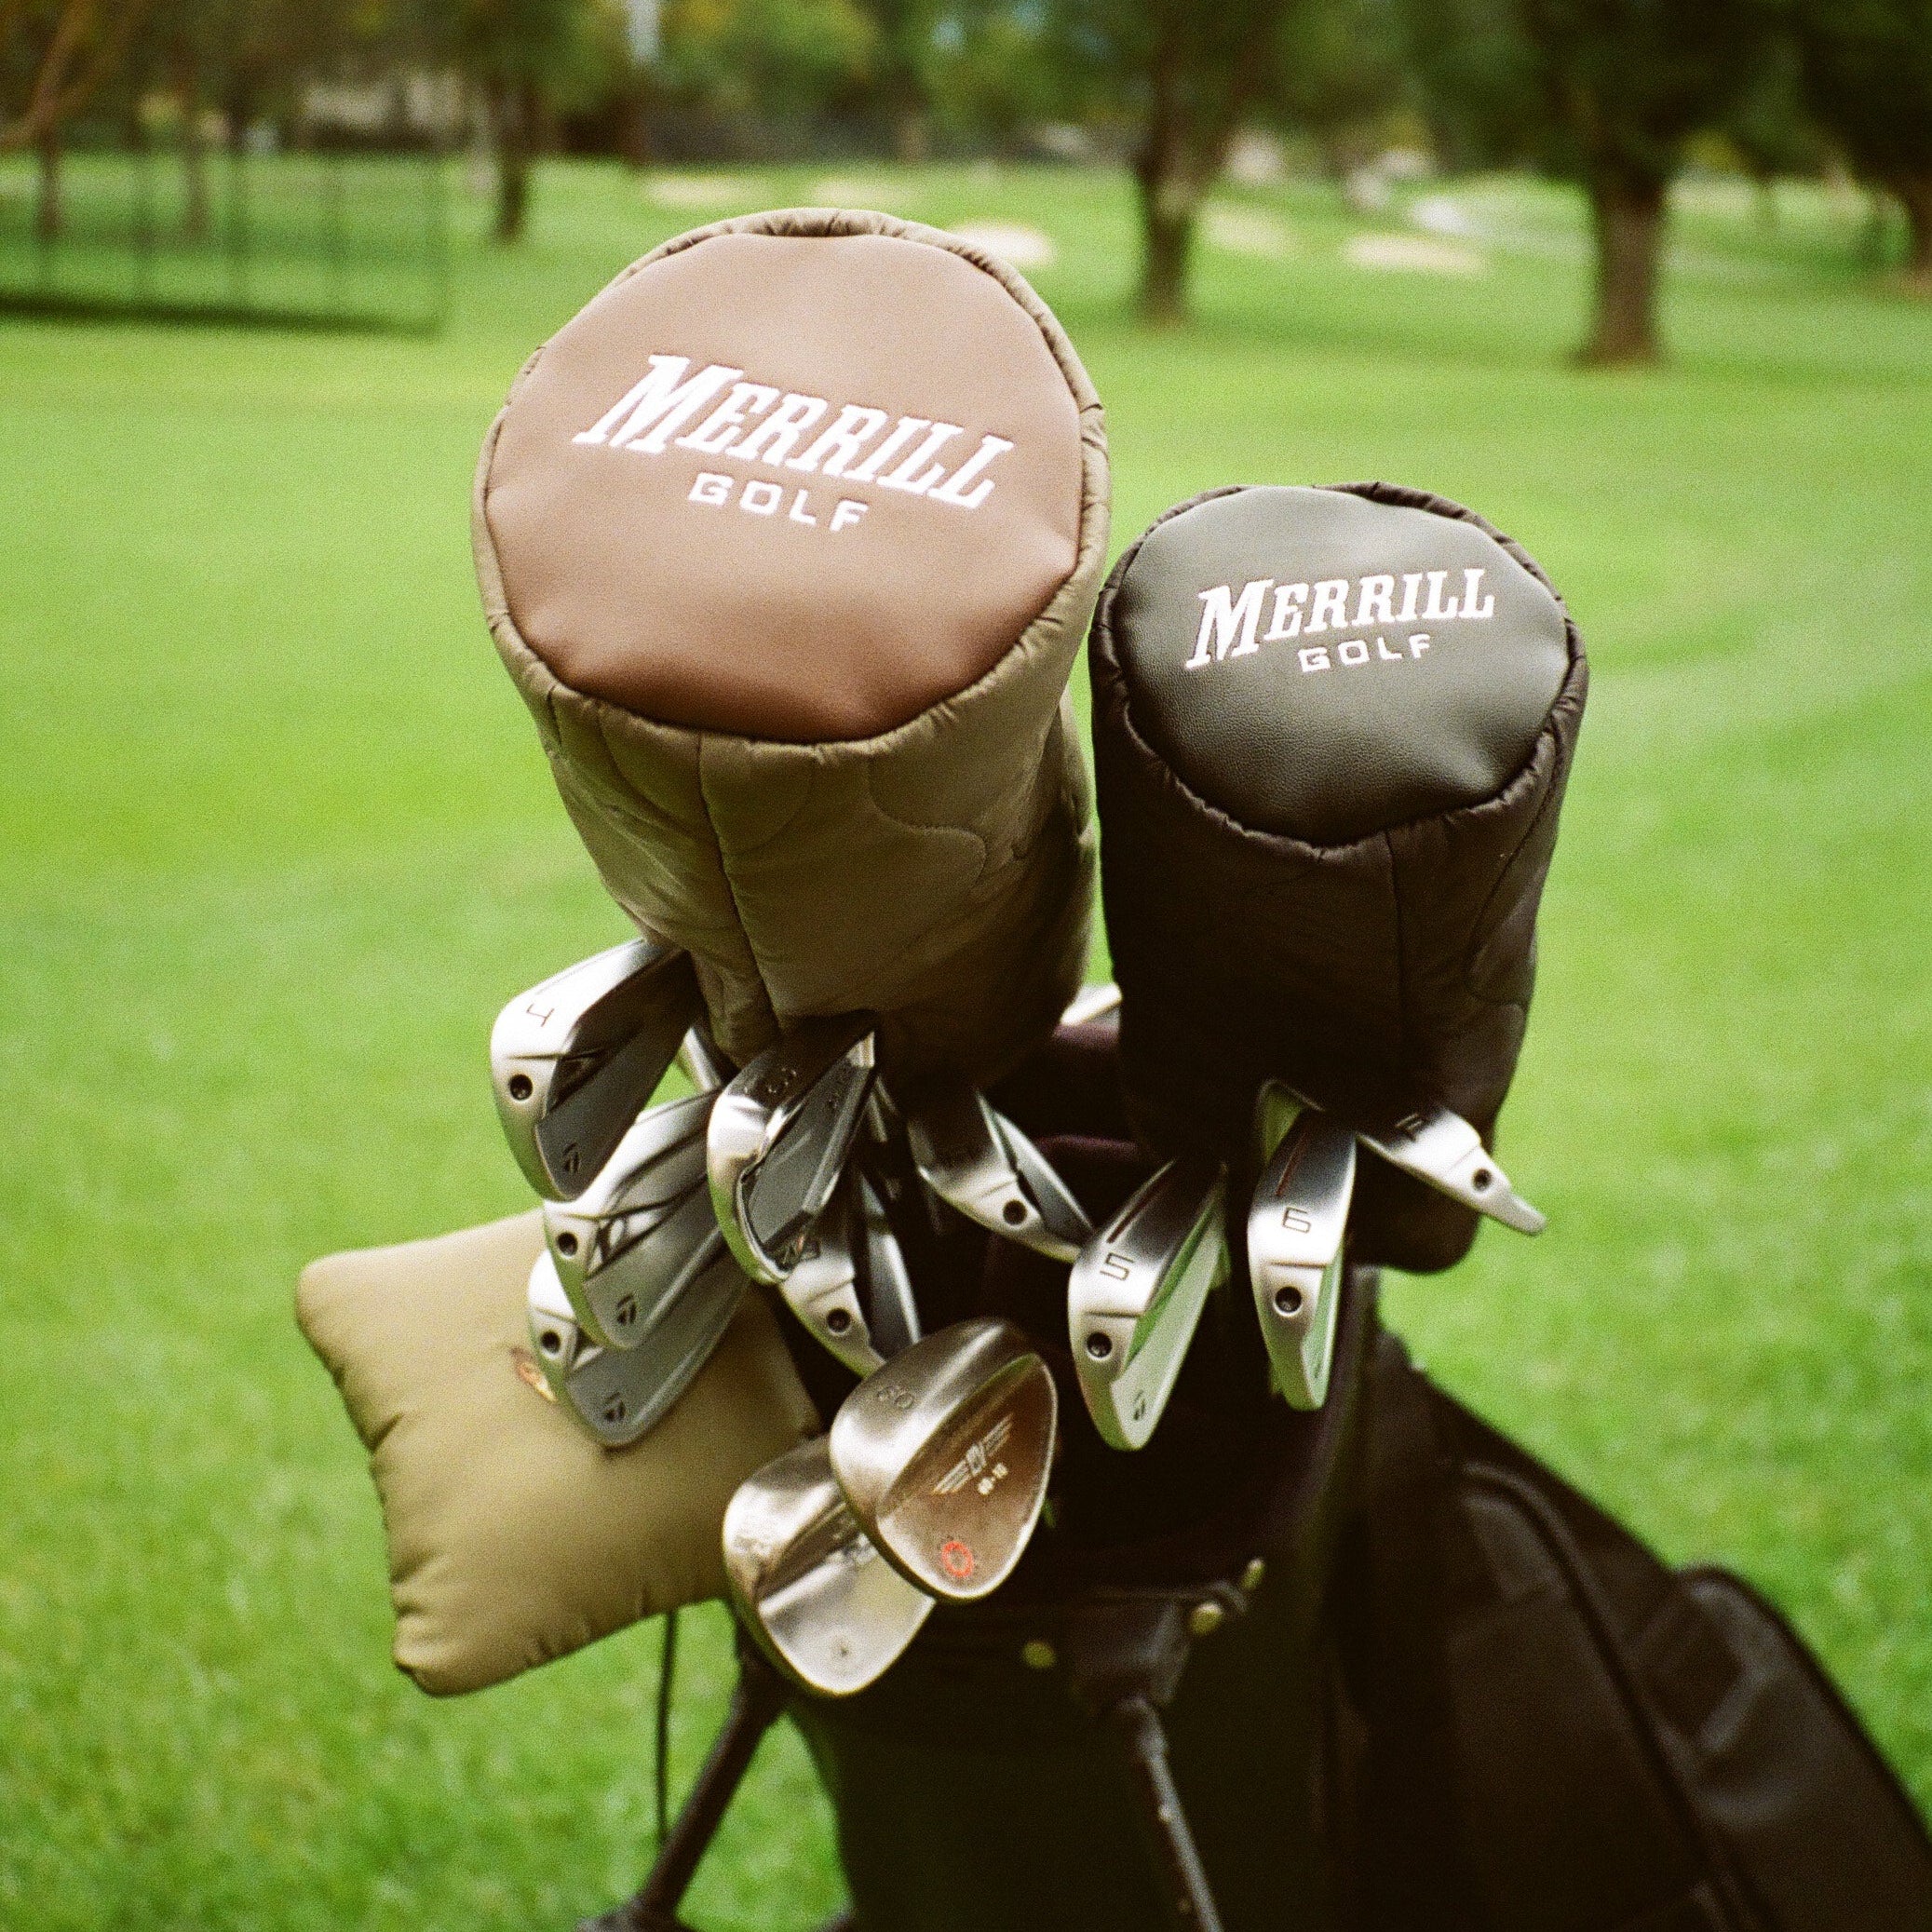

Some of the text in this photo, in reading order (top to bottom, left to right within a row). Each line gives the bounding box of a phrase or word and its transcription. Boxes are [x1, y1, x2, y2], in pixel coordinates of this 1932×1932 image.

[572, 354, 1015, 509] MERRILL
[688, 471, 868, 532] GOLF
[1185, 568, 1495, 669] MERRILL
[1297, 634, 1430, 672] GOLF
[526, 1003, 555, 1028] 4
[1281, 1206, 1312, 1235] 6
[1100, 1251, 1134, 1282] 5
